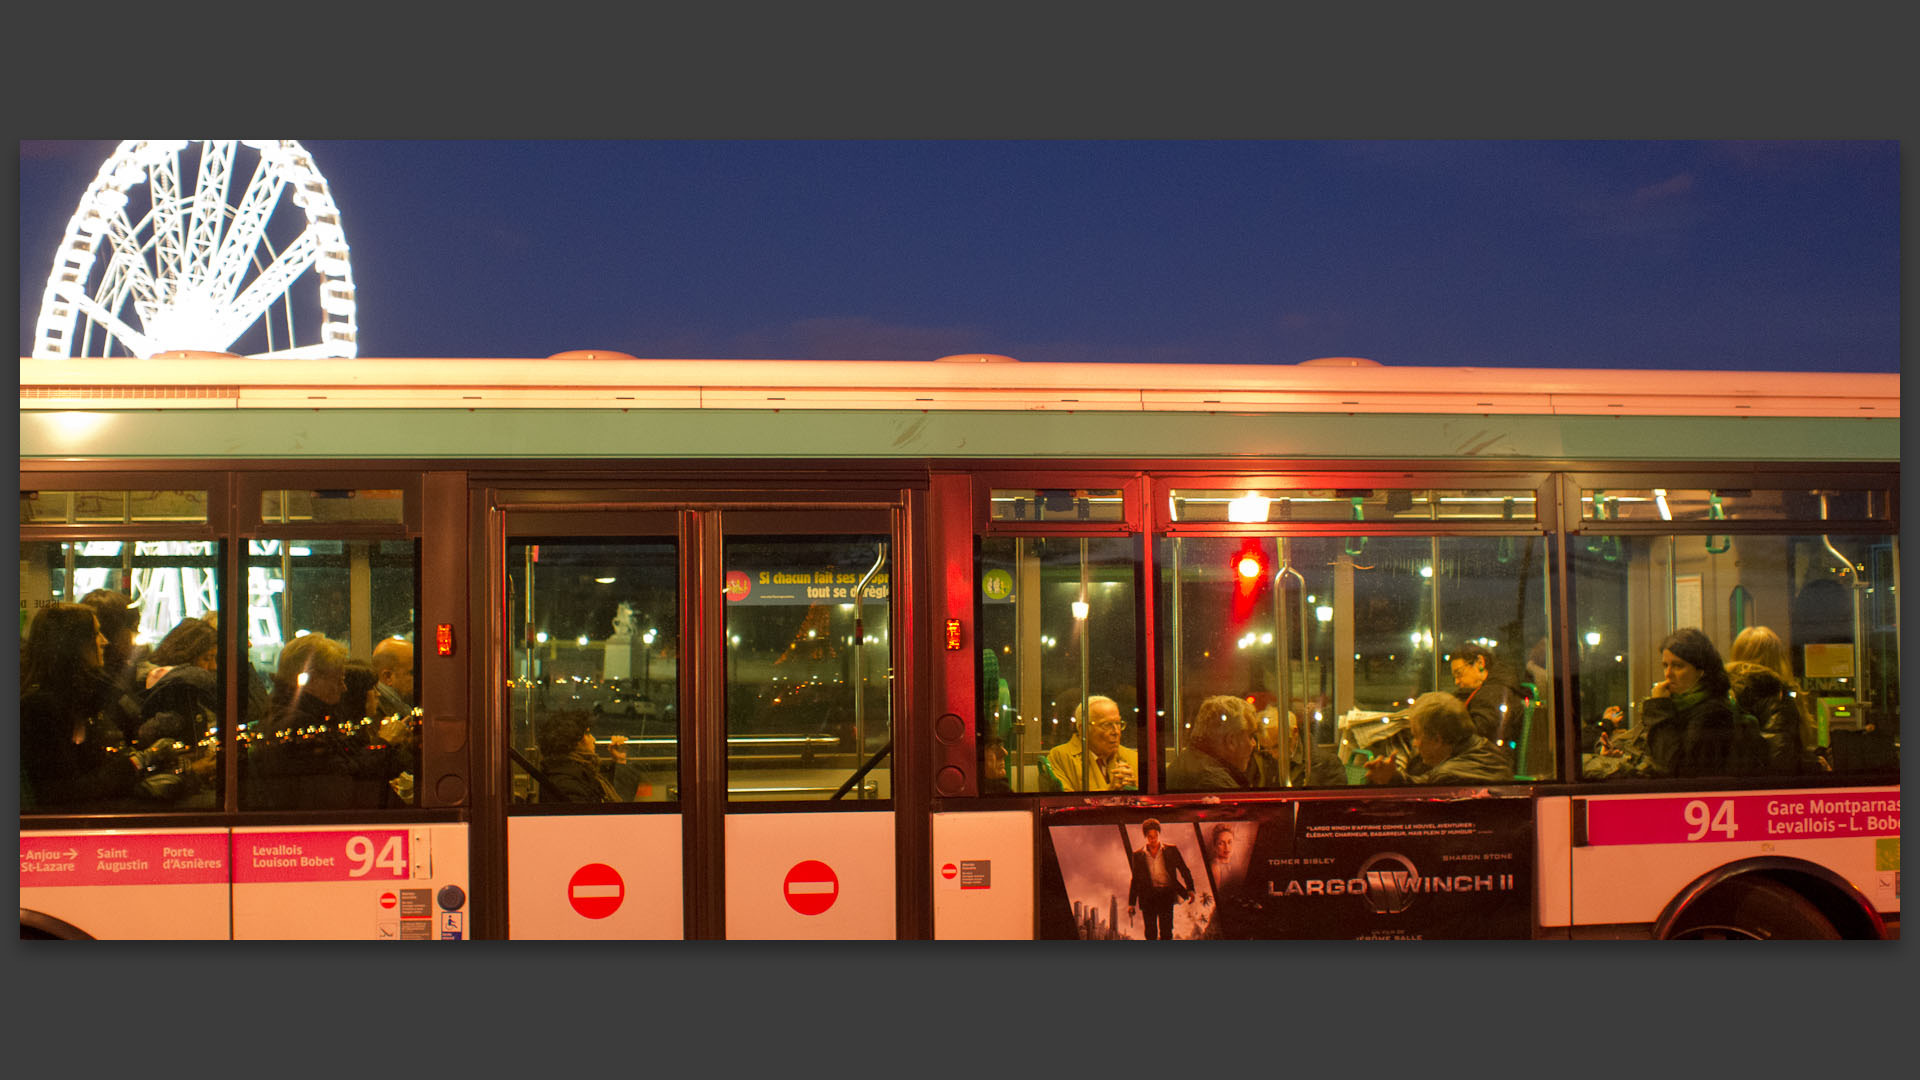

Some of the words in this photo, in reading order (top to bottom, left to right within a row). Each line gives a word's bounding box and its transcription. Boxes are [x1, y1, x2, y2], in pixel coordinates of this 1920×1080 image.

[759, 571, 770, 585] Si
[773, 571, 811, 585] chacun
[814, 571, 833, 585] fait
[836, 573, 856, 585] ses
[806, 586, 830, 598] tout
[833, 587, 847, 598] se
[1767, 800, 1805, 816] Gare
[1683, 799, 1739, 841] 94
[1768, 817, 1836, 834] Levallois
[1849, 816, 1863, 832] L.
[1867, 815, 1900, 831] Bob
[25, 849, 60, 862] Anjou
[96, 848, 128, 858] Saint
[162, 847, 195, 858] Porte
[253, 845, 303, 856] Levallois
[345, 835, 407, 877] 94
[21, 862, 75, 873] St-Lazare
[96, 859, 149, 872] Augustin
[162, 858, 222, 869] d'Asnières
[253, 857, 297, 868] Louison
[300, 856, 335, 867] Bobet
[1268, 878, 1368, 896] LARGO
[1399, 875, 1493, 893] WINCH
[1500, 874, 1514, 890] II
